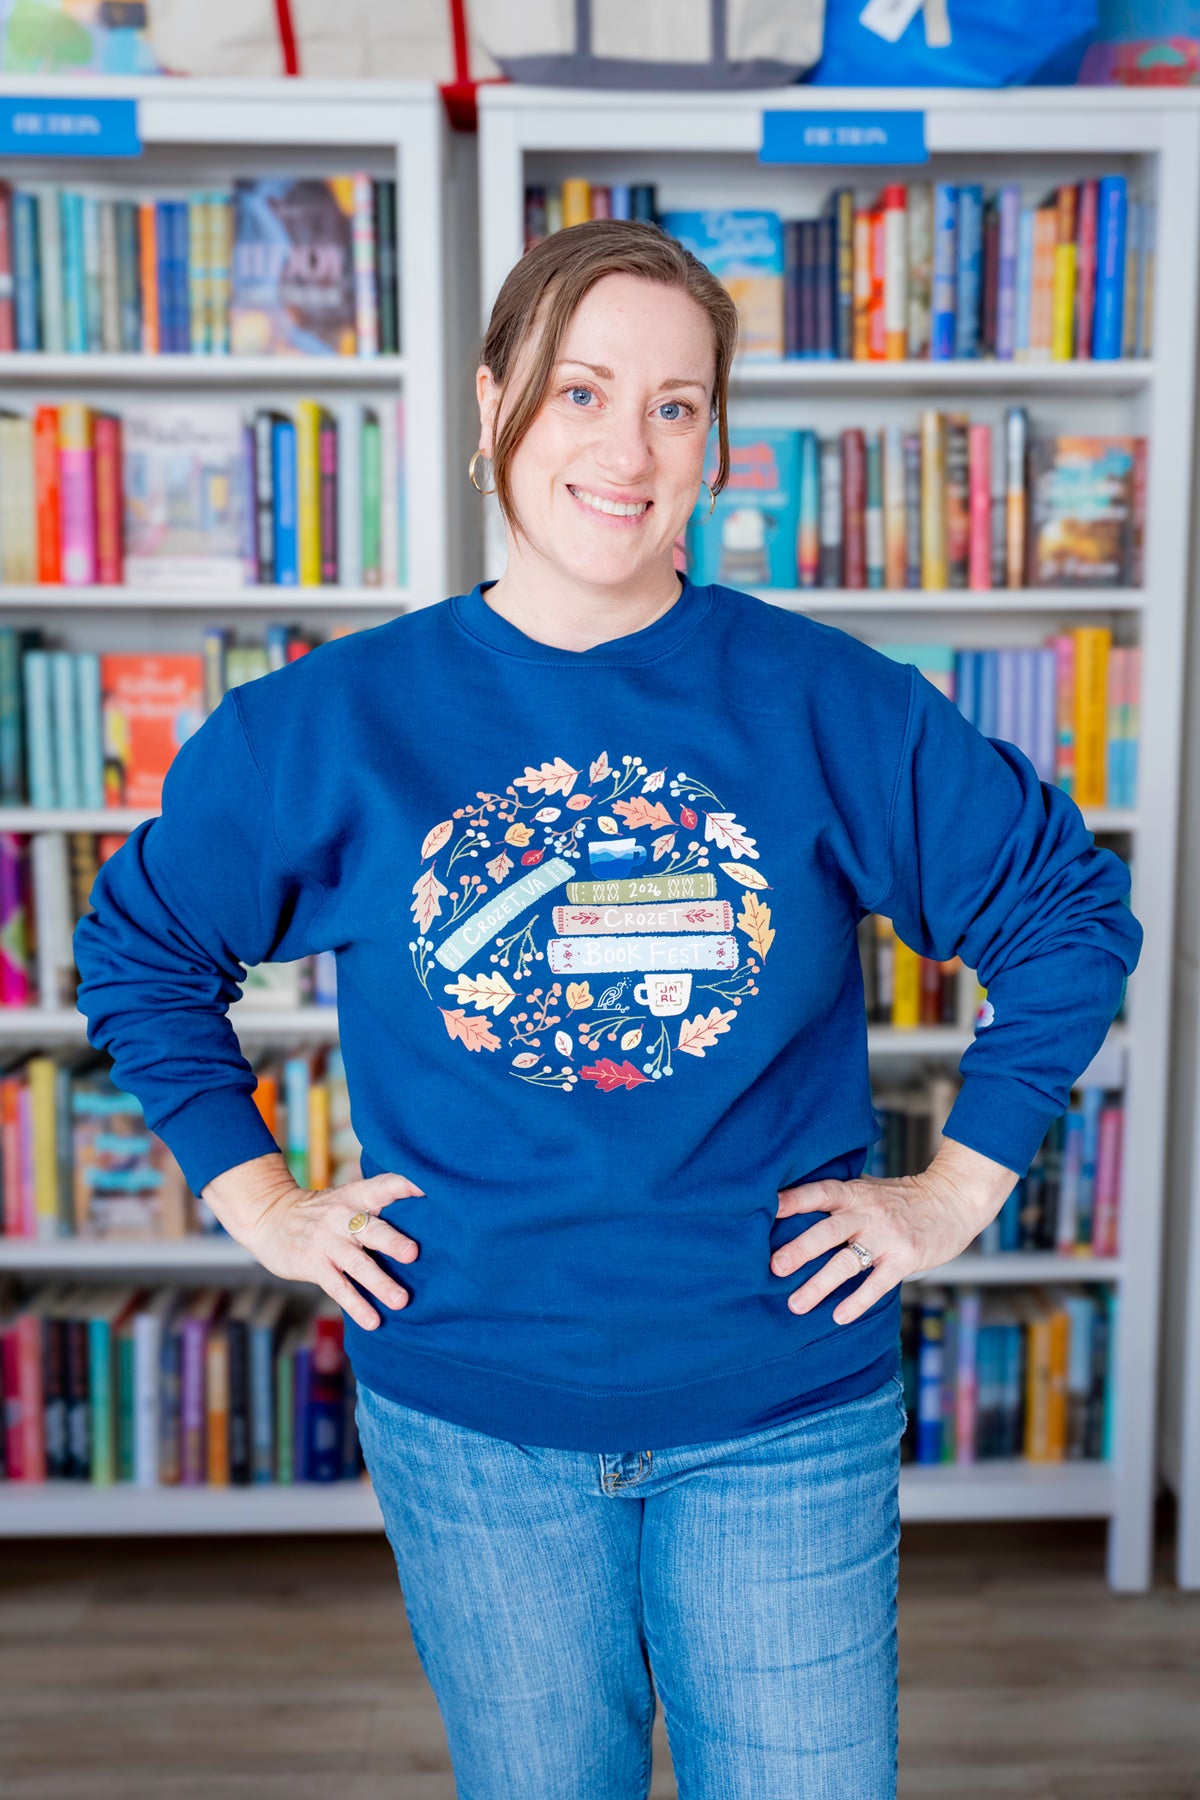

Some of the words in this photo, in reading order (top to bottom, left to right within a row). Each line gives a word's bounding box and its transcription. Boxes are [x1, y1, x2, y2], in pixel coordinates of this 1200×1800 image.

[462, 891, 527, 945] CROZET,
[519, 878, 547, 896] VA
[603, 909, 683, 928] CROZET
[582, 941, 641, 966] BOOK
[650, 941, 705, 966] FEST
[660, 985, 677, 993] JM
[660, 994, 677, 1002] RL
